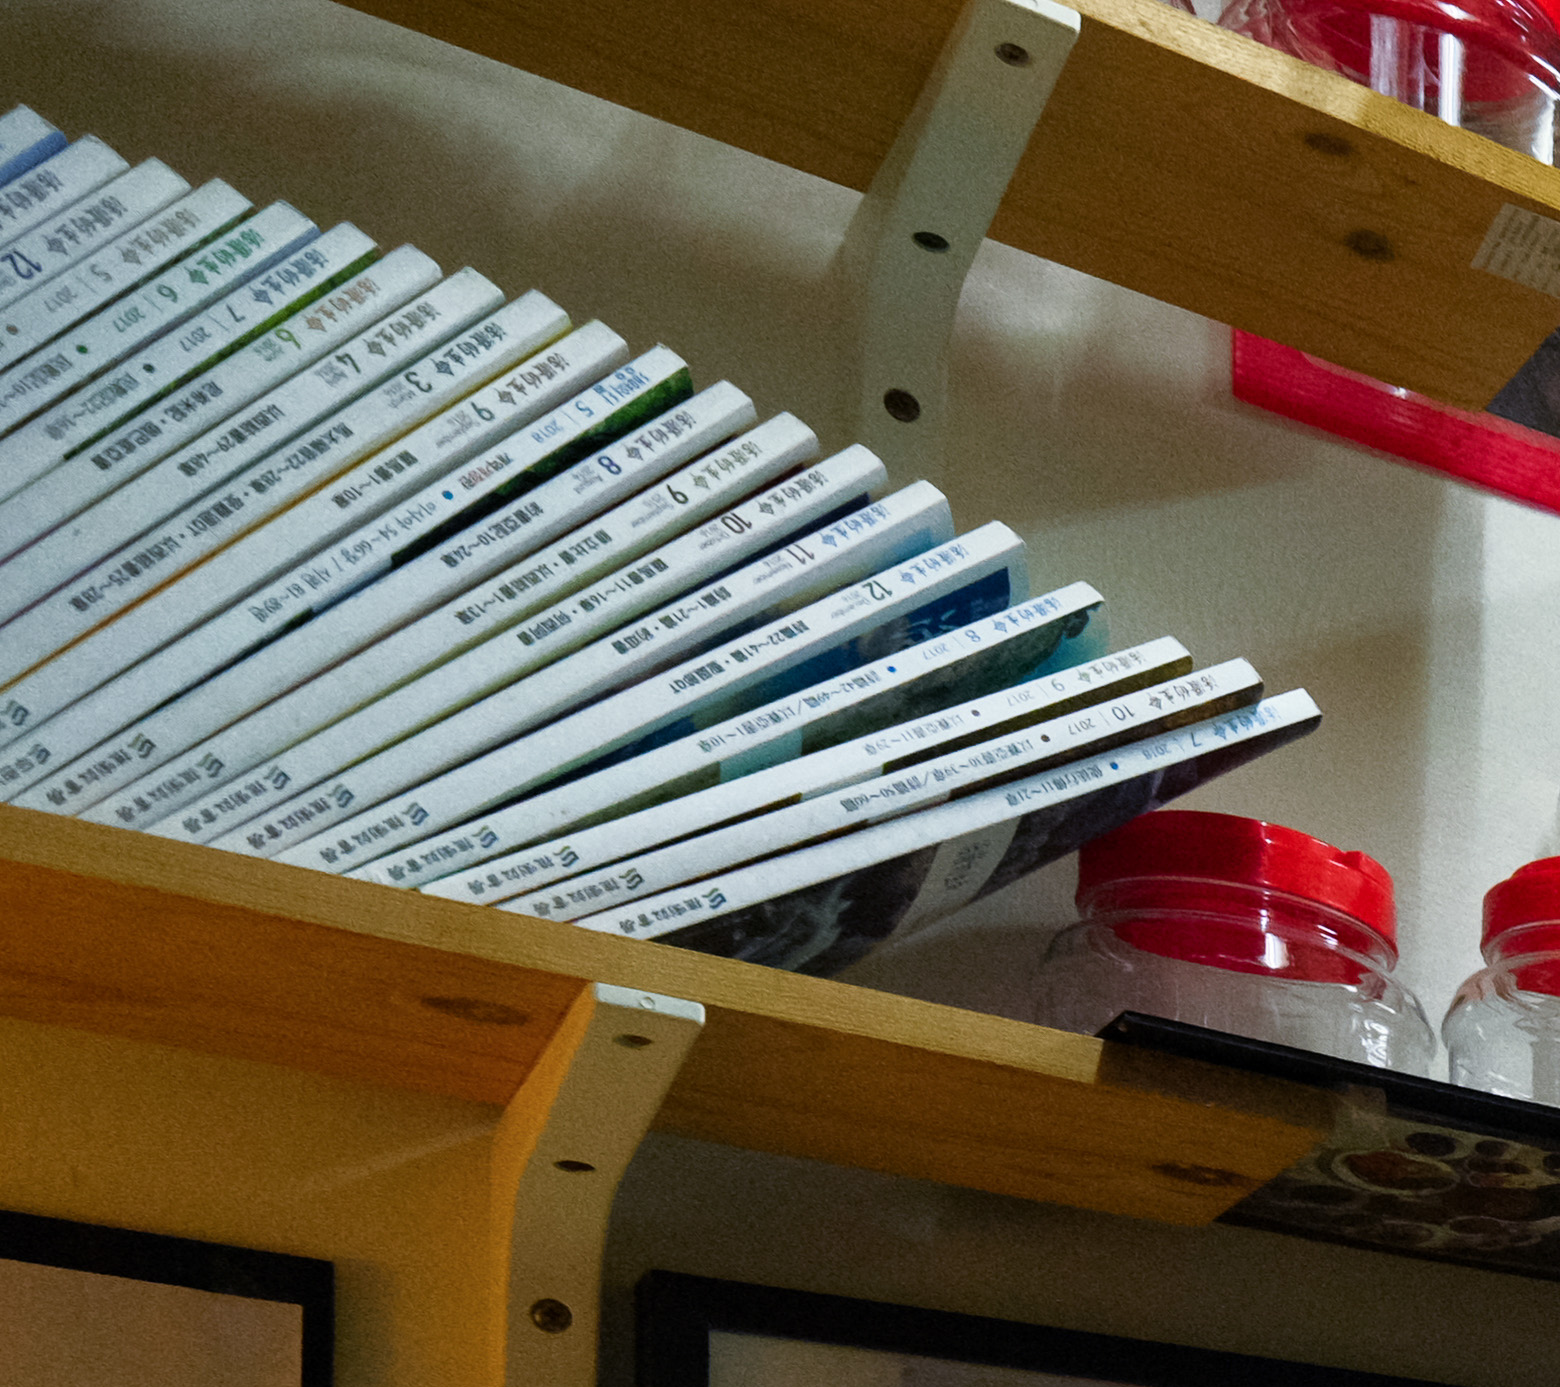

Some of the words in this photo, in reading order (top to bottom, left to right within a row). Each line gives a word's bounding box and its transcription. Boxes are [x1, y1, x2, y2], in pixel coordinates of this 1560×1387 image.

[0, 249, 43, 280] 12
[187, 229, 261, 285] 活潑的生命
[251, 250, 325, 304] 活潑的生命
[156, 284, 179, 302] 6
[304, 278, 376, 332] 活潑的生命
[112, 306, 146, 333] 2017
[225, 304, 246, 324] 7
[179, 326, 211, 352] 2017
[272, 325, 302, 350] 6
[365, 303, 436, 356] 活潑的生命
[433, 323, 503, 375] 活潑的生命
[334, 352, 361, 374] 4
[403, 370, 433, 394] 3
[497, 353, 568, 404] 活潑的生命
[470, 401, 496, 423] 9
[574, 400, 595, 418] 5
[531, 419, 563, 444] 2018
[626, 412, 693, 460] 活潑的生命
[596, 455, 623, 476] 8
[692, 442, 758, 489] 活潑的生命
[666, 484, 690, 505] 9
[759, 471, 824, 515] 活潑的生命
[718, 505, 753, 535] 10
[820, 499, 885, 546] 活潑的生命
[783, 537, 815, 565] 11
[900, 545, 965, 584] 活潑的生命
[861, 580, 893, 602] 12
[993, 591, 1058, 633] 活潑的生命
[964, 628, 982, 643] 8
[922, 642, 949, 661] 2017
[1078, 652, 1141, 683] 活潑的生命
[1006, 689, 1034, 707] 2017
[1050, 678, 1066, 692] 9
[1149, 676, 1214, 710] 活潑的生命
[1068, 717, 1095, 736] 2017
[1111, 705, 1135, 722] 10
[1212, 704, 1281, 740] 活潑的生命
[1186, 728, 1200, 747] 7
[1141, 742, 1173, 760] 2018
